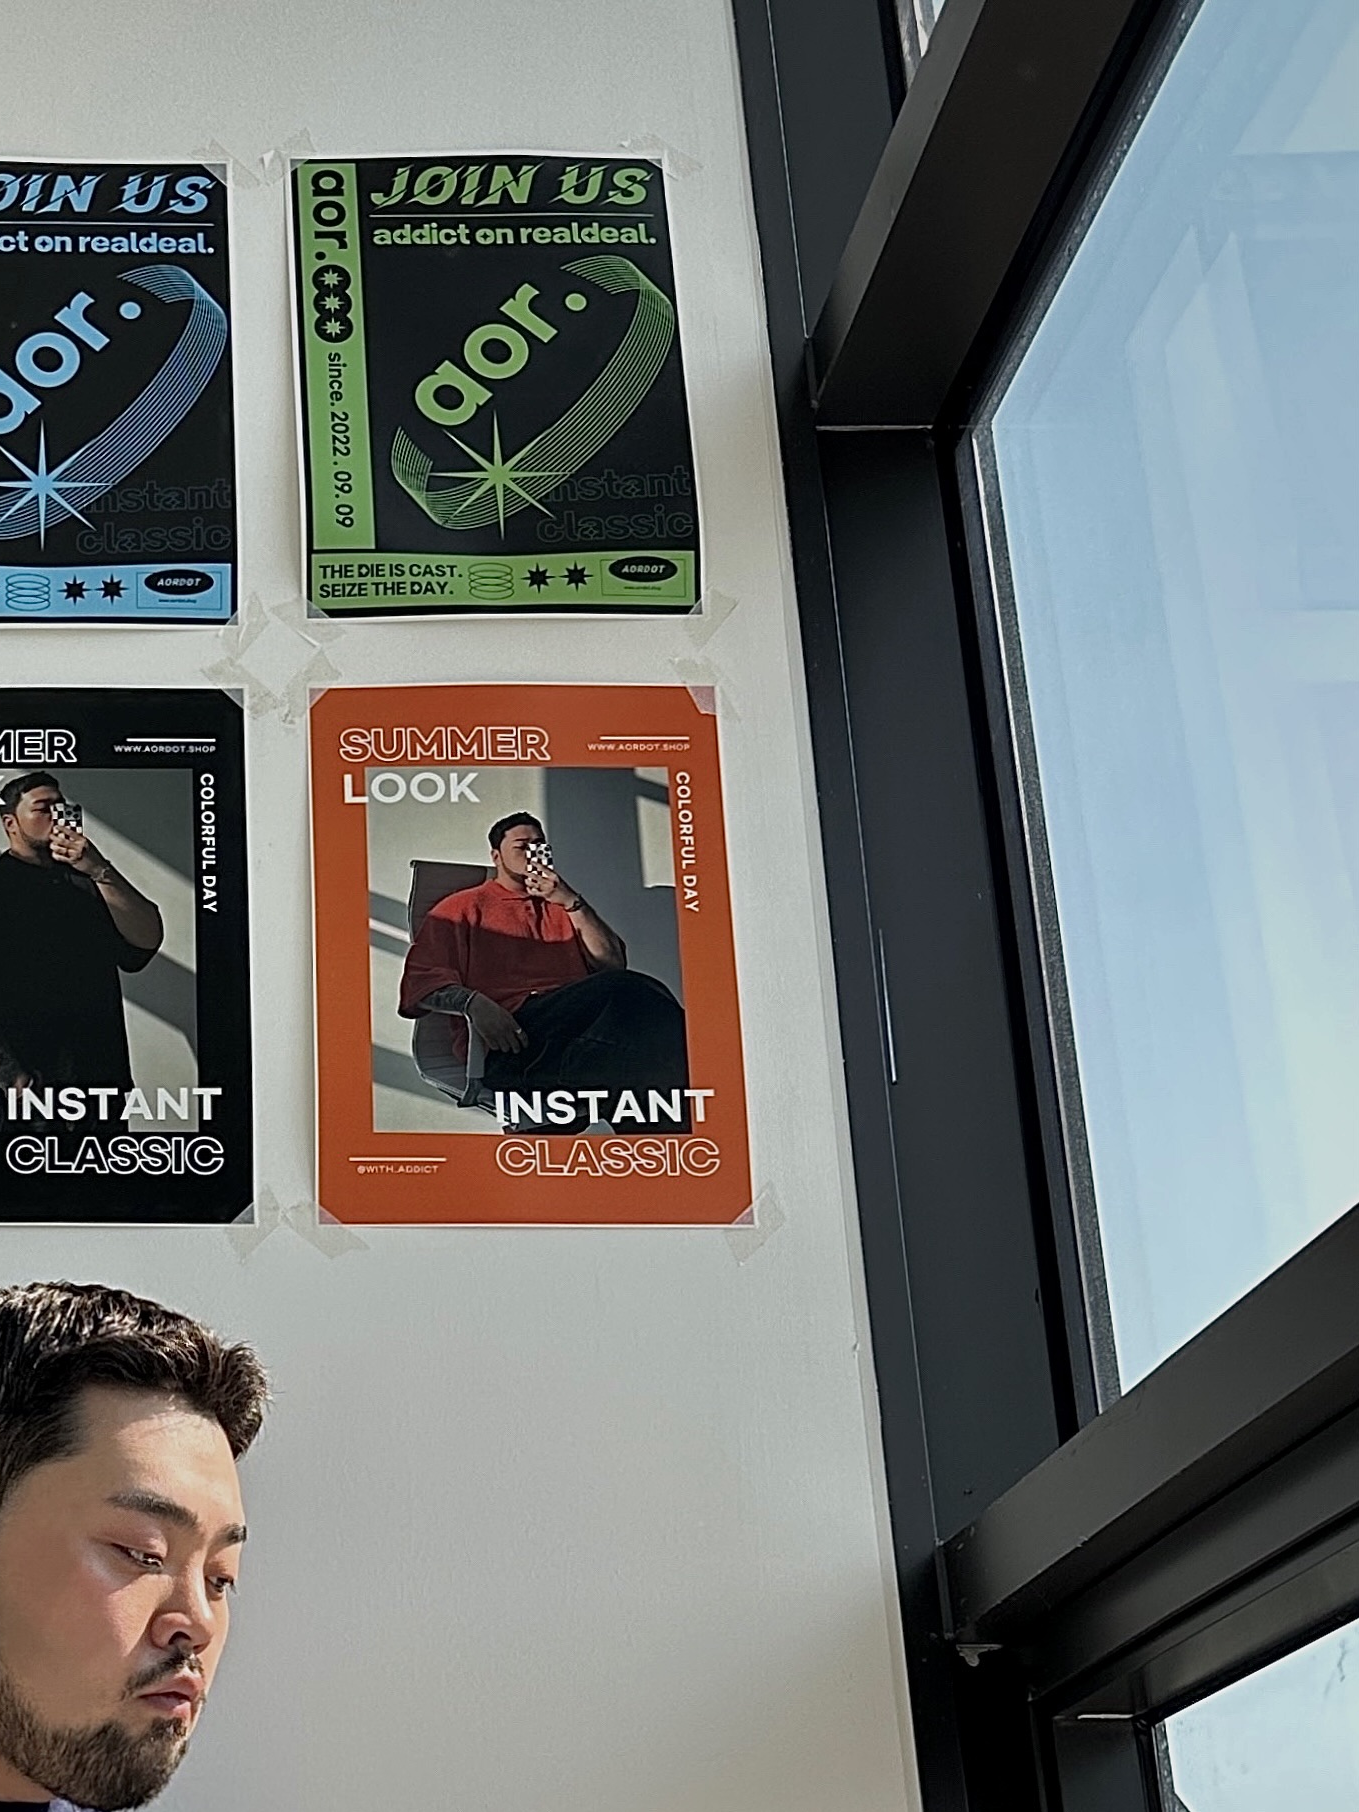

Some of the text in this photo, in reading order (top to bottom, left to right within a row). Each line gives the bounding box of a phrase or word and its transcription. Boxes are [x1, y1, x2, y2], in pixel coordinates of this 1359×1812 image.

[107, 173, 218, 215] US
[370, 163, 653, 209] JOIN US
[35, 235, 72, 253] on
[79, 232, 214, 255] realdeal.
[373, 222, 656, 246] addict on realdeal.
[83, 478, 231, 513] nstant
[543, 465, 691, 502] nstant
[76, 516, 231, 555] classic
[537, 503, 693, 542] classic
[157, 578, 201, 586] AORDOT
[319, 564, 462, 579] THE DIE IS CAST.
[621, 565, 665, 573] AORDOT
[319, 581, 454, 598] SEIZE THE DAY.
[339, 727, 551, 762] SUMMER
[343, 772, 479, 804] LOOK
[200, 773, 218, 912] COLORFUL DAY
[676, 771, 699, 912] COLORFUL DAY
[7, 1087, 223, 1121] INSTANT
[495, 1088, 714, 1124] INSTANT
[6, 1136, 225, 1175] CLASSIC
[496, 1138, 720, 1178] CLASSIC
